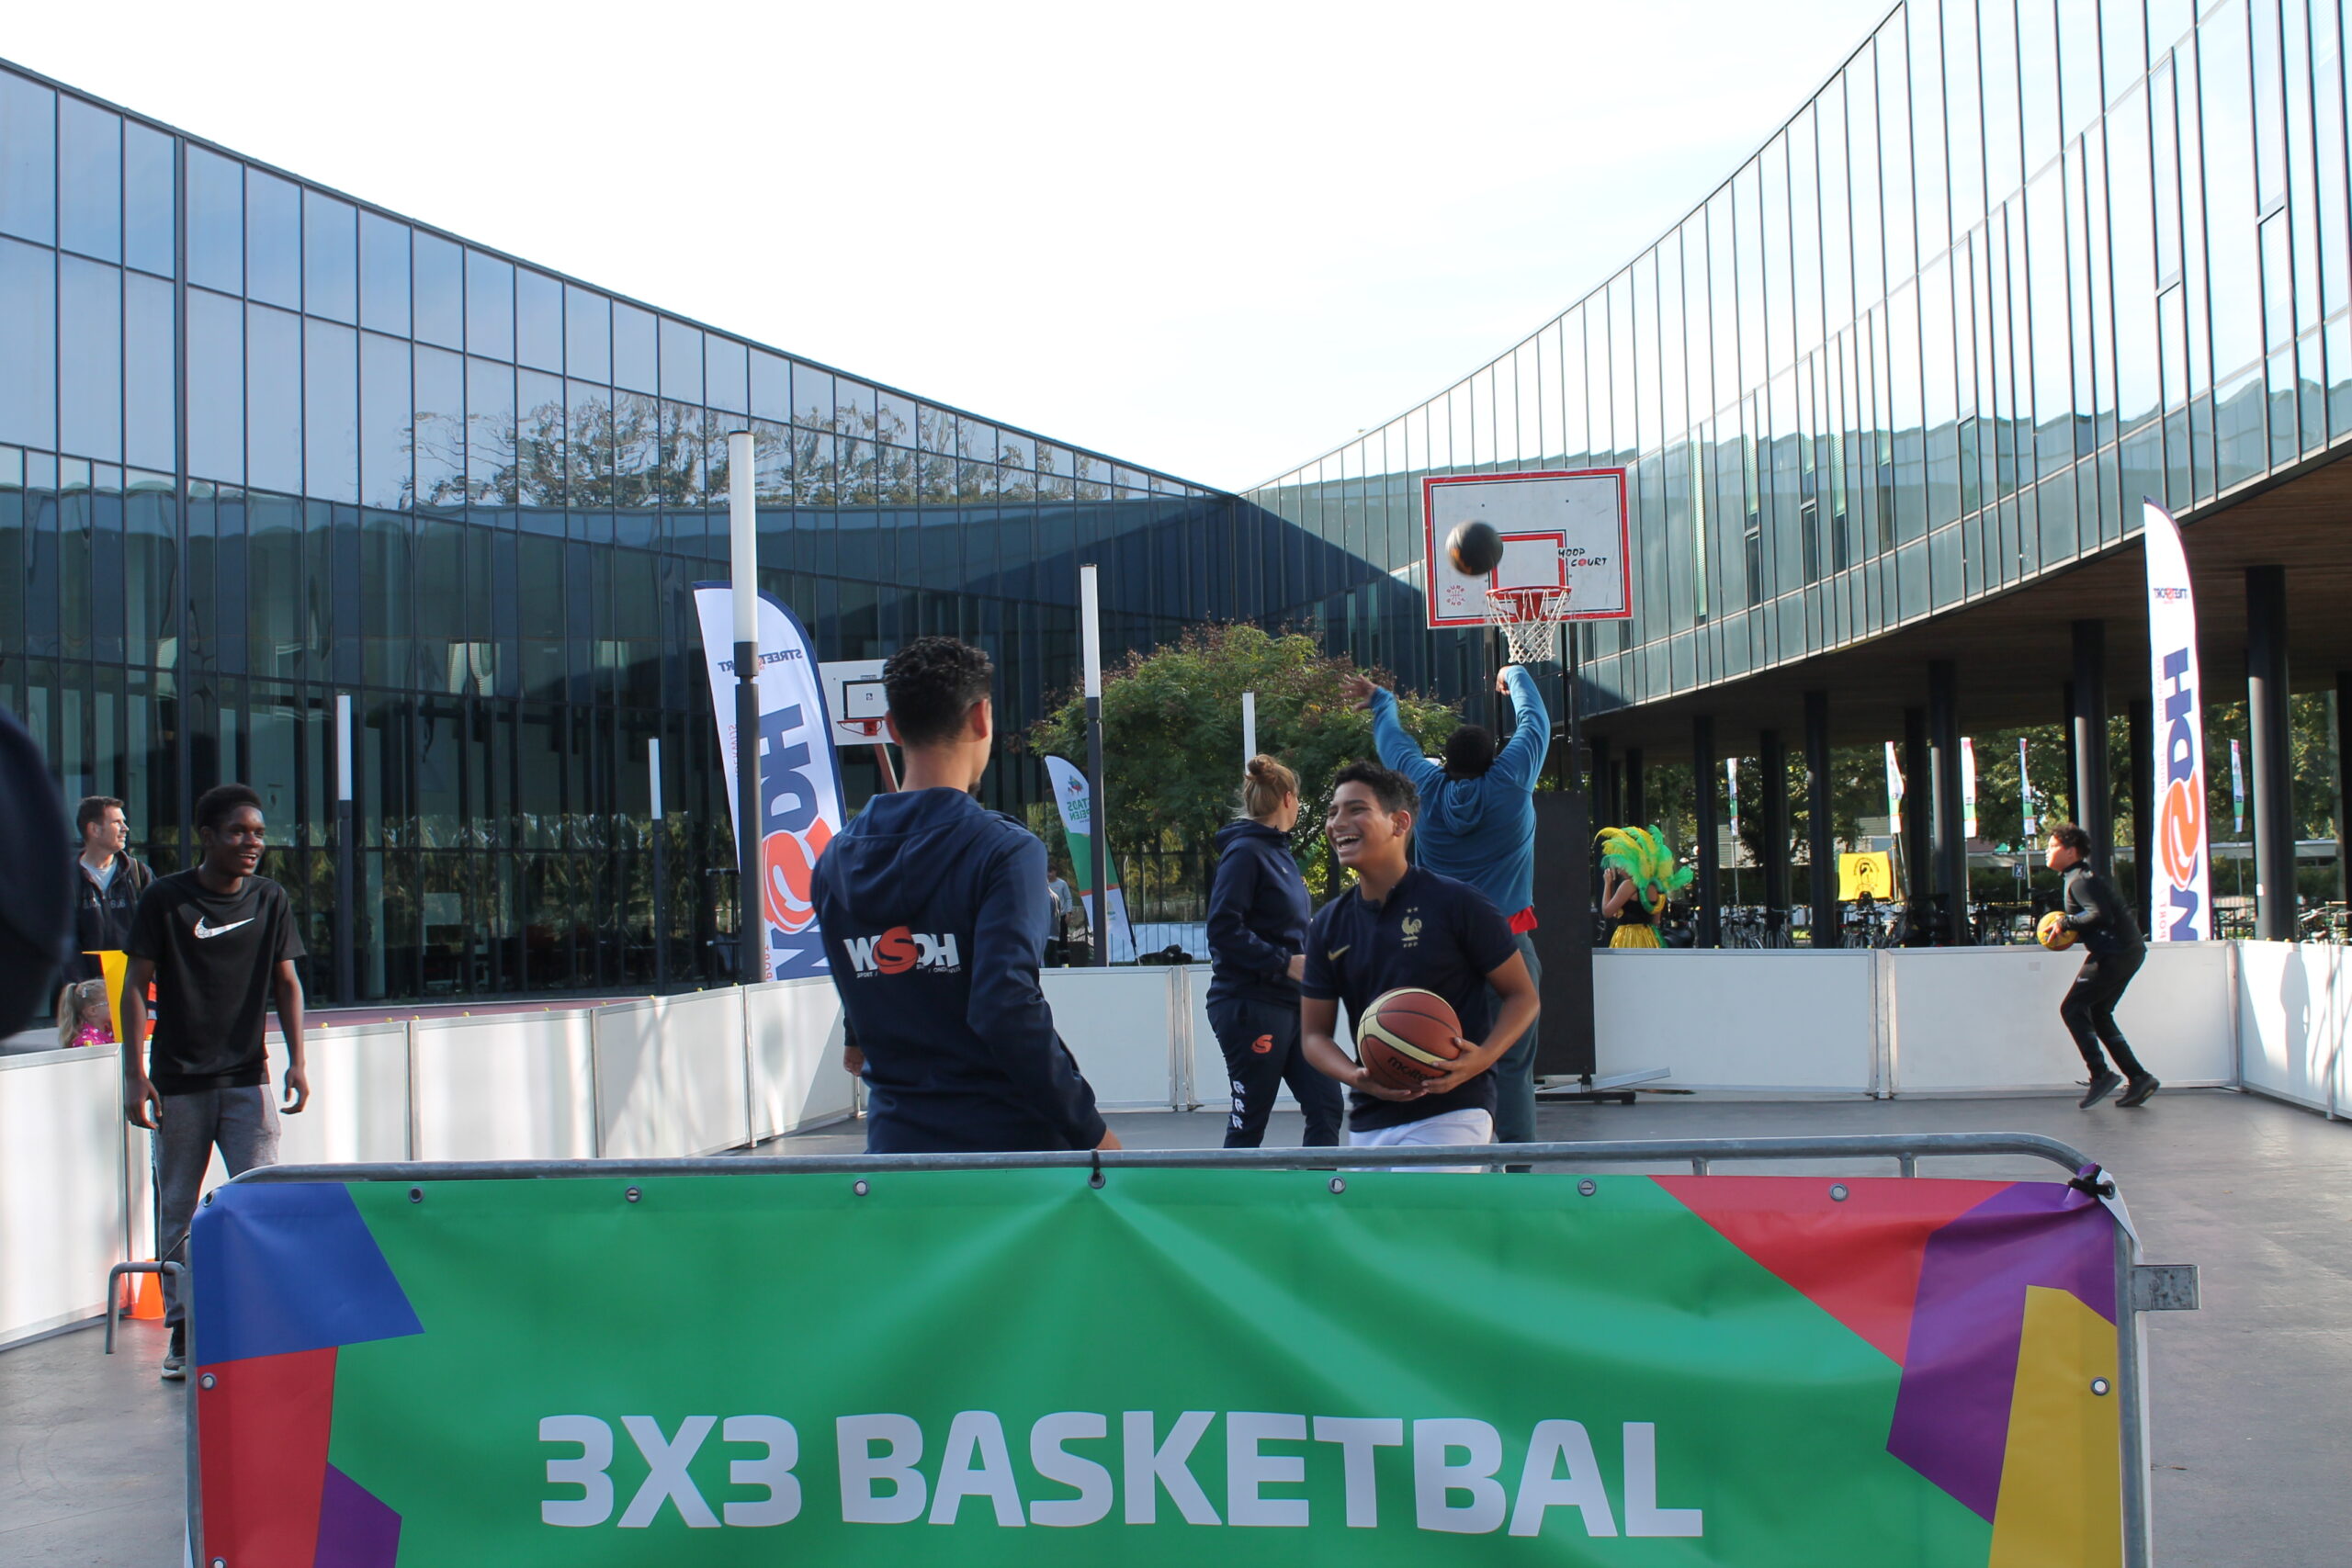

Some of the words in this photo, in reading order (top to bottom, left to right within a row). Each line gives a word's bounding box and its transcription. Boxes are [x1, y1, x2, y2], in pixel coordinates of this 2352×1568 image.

[1558, 547, 1586, 558] HOOP
[1570, 557, 1608, 568] COURT
[537, 1413, 802, 1529] 3X3
[834, 1410, 1704, 1539] BASKETBAL
